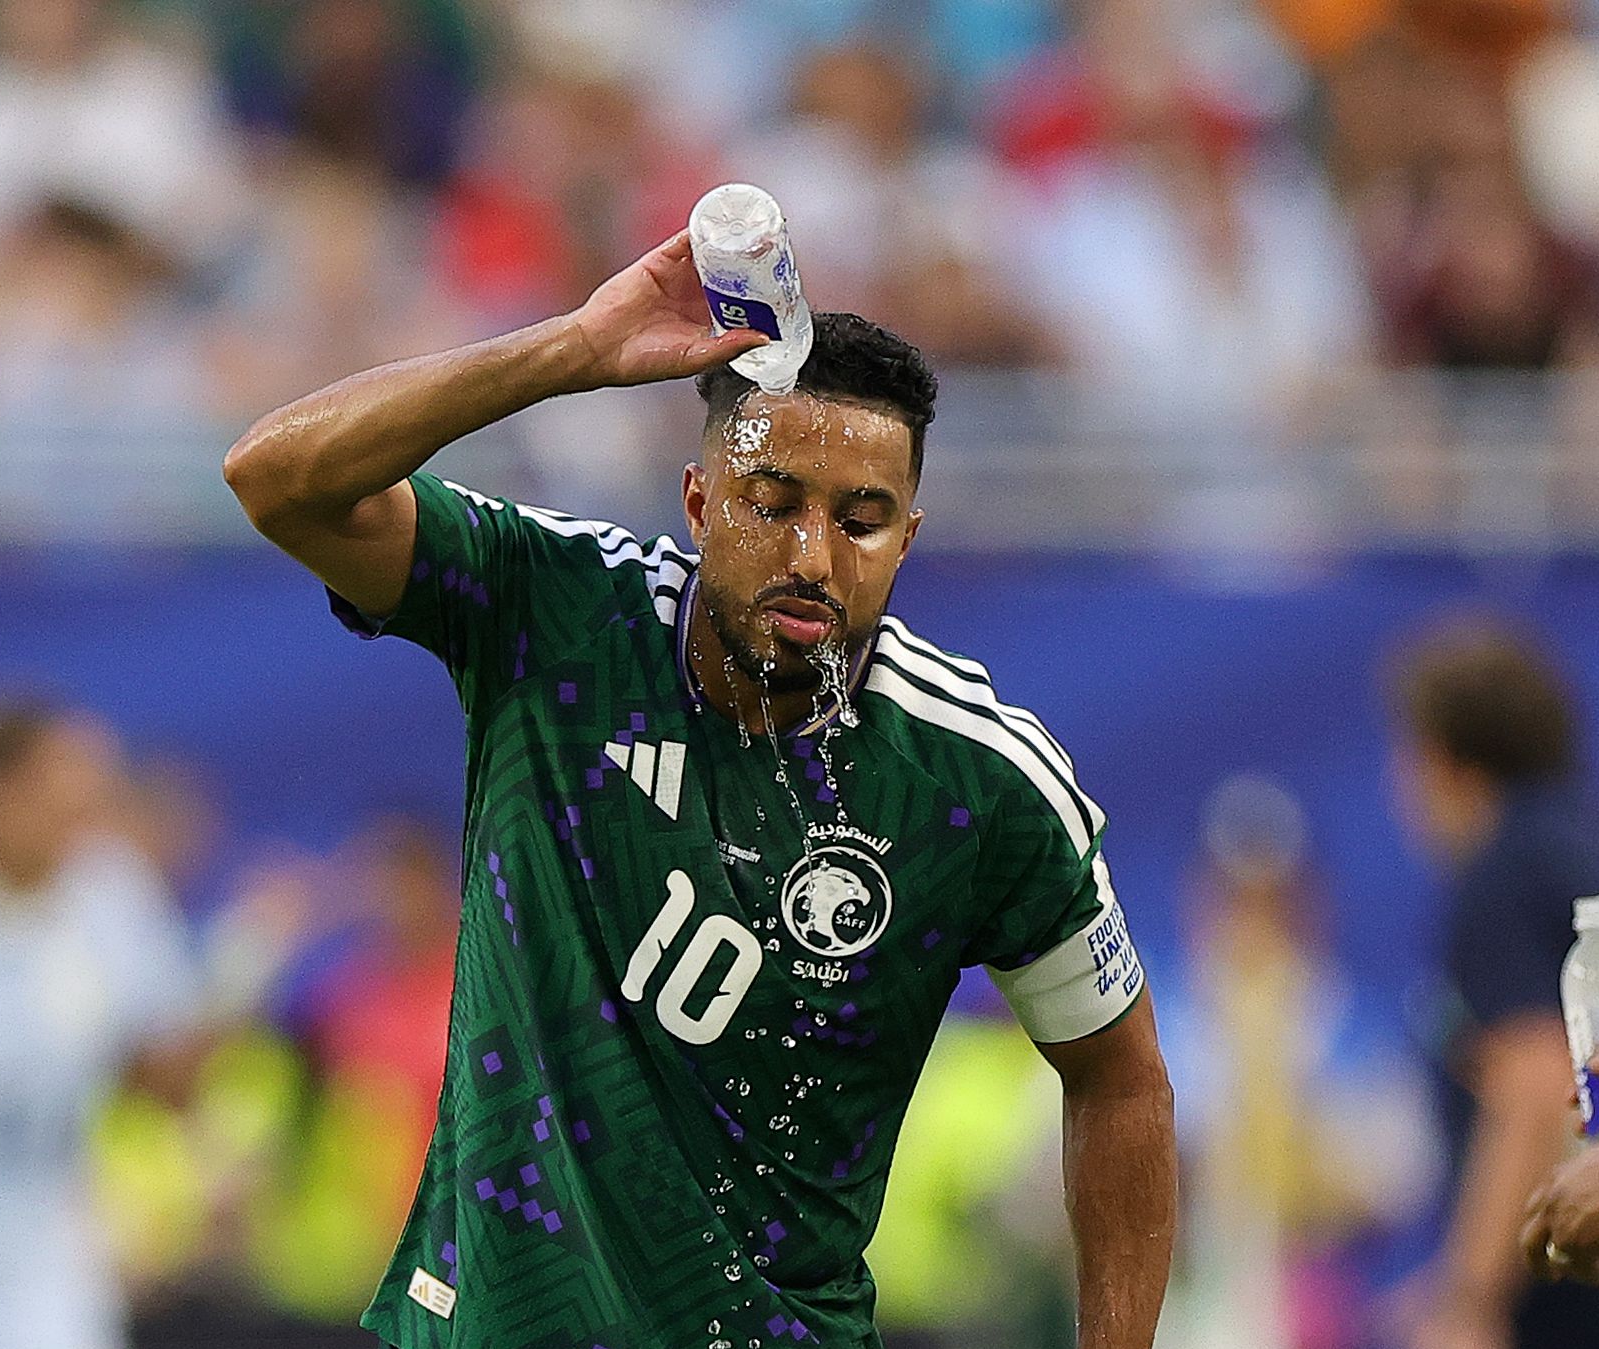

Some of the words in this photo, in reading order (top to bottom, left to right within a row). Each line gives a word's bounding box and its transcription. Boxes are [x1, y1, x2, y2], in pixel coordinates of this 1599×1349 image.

[807, 822, 893, 856] السعودية
[835, 915, 867, 930] SAFF
[619, 868, 763, 1045] 10
[791, 960, 850, 983] SAUDI
